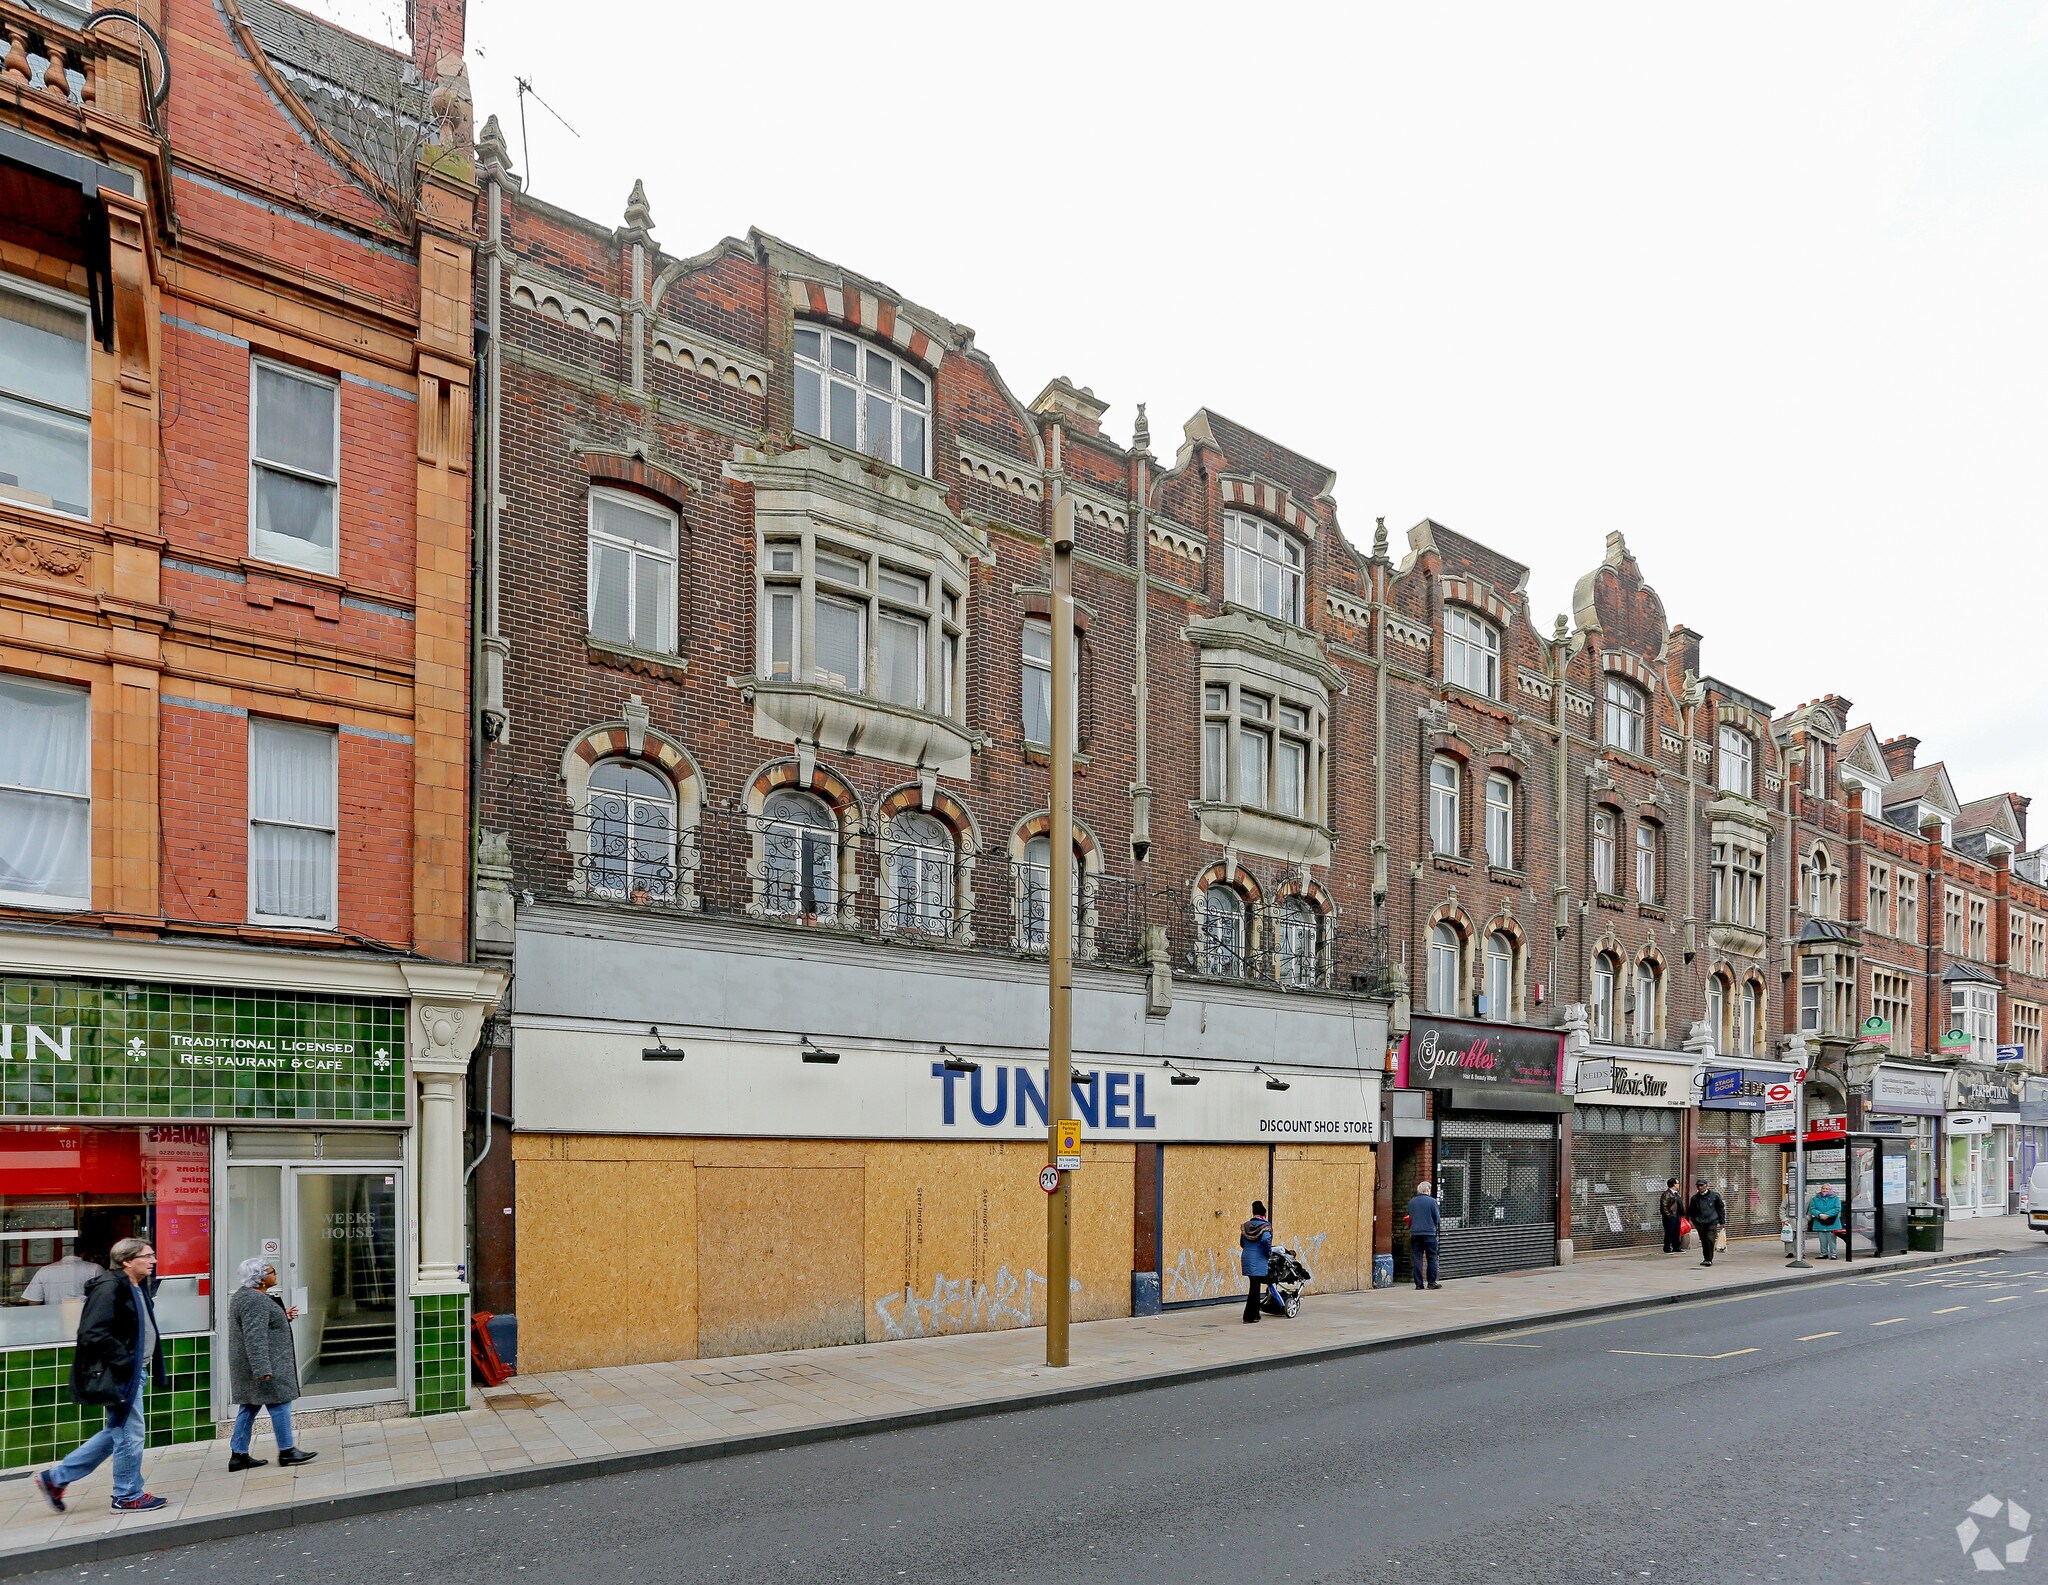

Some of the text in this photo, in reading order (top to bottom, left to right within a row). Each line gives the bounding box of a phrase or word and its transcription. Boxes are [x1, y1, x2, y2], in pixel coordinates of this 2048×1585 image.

[171, 1034, 354, 1053] TRADITIONAL LICENSED
[180, 1053, 286, 1068] RESTAURANT
[1418, 1029, 1496, 1080] Sparkles
[1582, 1071, 1609, 1080] REID'S
[1795, 1070, 1803, 1079] Z
[1640, 1074, 1668, 1097] Store
[1714, 1077, 1735, 1087] STAGE
[1714, 1083, 1735, 1092] DOOR
[1904, 1085, 1920, 1096] Dental
[1971, 1083, 2009, 1100] PERFECTION
[1260, 1119, 1373, 1134] DISCOUNT SHOE STORE
[321, 1212, 376, 1225] WEEKS
[321, 1226, 375, 1239] HOUSE
